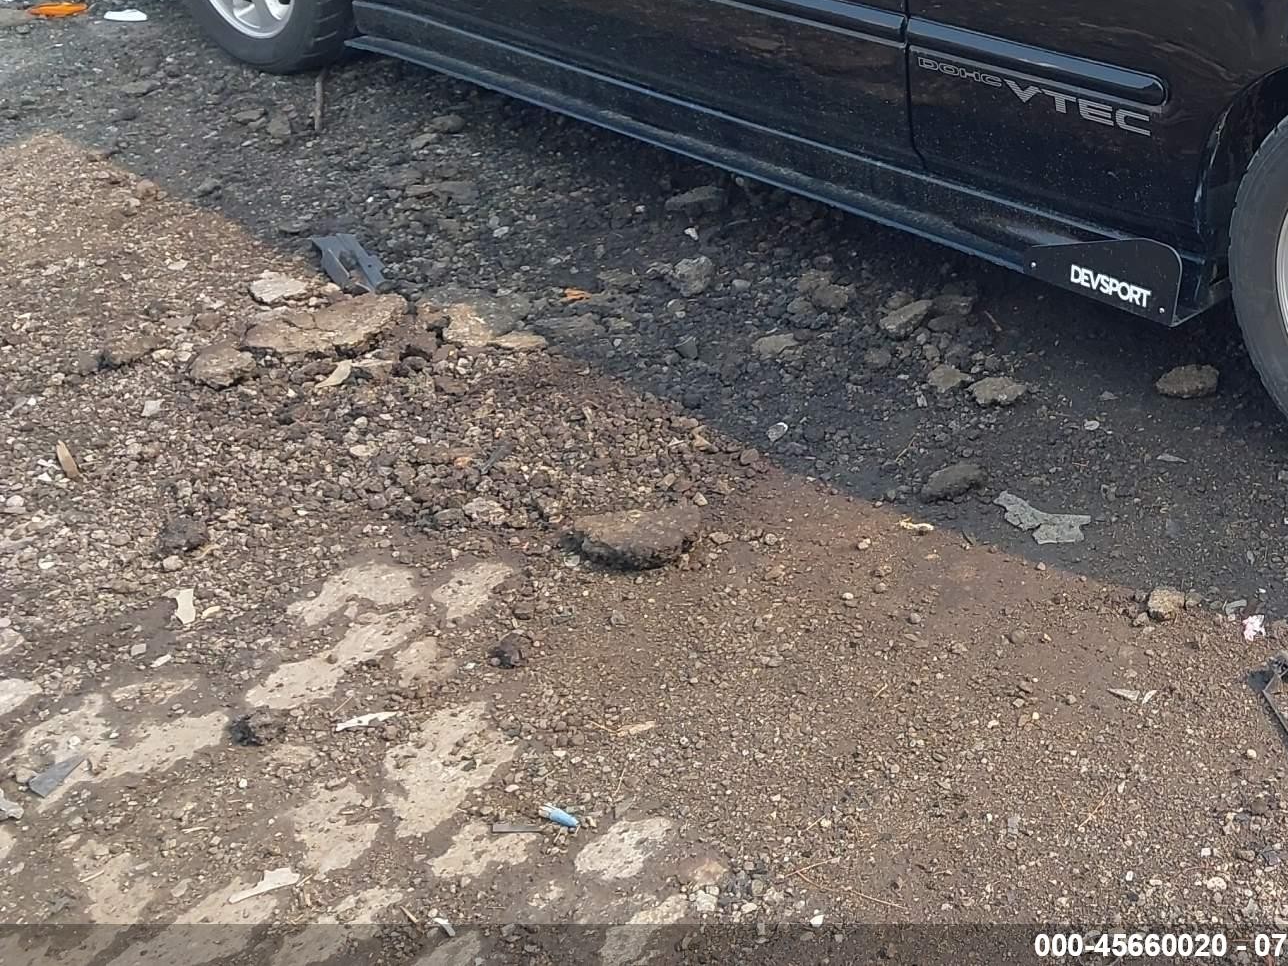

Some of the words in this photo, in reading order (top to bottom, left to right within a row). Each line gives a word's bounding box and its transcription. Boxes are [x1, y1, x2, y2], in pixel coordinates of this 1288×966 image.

[917, 56, 1002, 87] DOHC
[1005, 79, 1151, 137] VTEC
[1070, 264, 1152, 308] DEVSPORT
